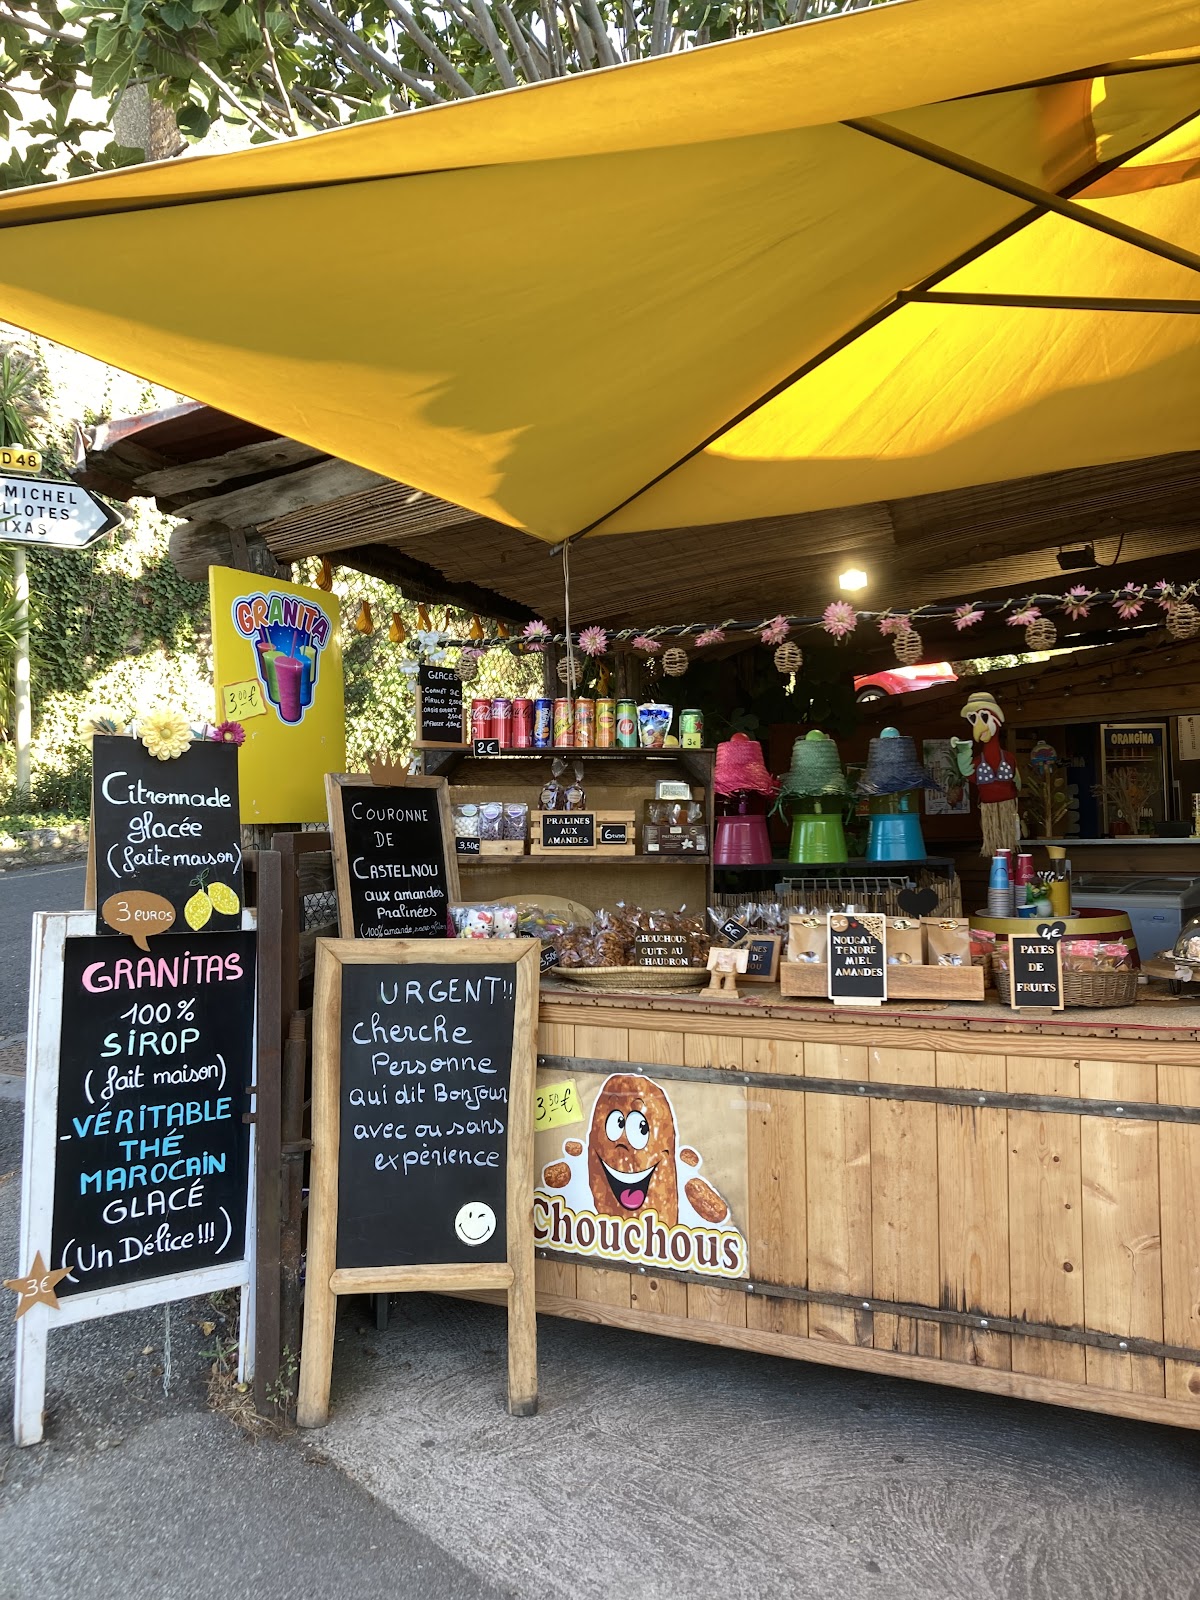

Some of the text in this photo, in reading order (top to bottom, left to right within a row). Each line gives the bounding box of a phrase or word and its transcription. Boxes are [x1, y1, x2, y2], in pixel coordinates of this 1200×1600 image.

[5, 485, 77, 505] MICHEL
[235, 598, 330, 643] GRANITA
[428, 670, 458, 681] GLACES
[1111, 730, 1155, 744] ORANGINA
[477, 742, 499, 754] 2€
[102, 771, 231, 808] Citronnade
[351, 802, 429, 822] COURONNE
[127, 811, 203, 844] glacée
[546, 817, 591, 825] PRALINES
[560, 827, 578, 835] AUX
[373, 831, 394, 848] DE
[458, 841, 480, 850] 3,50€
[547, 836, 589, 844] AMANDES
[352, 857, 438, 880] CASTELNOU
[364, 886, 445, 901] aux amandes
[116, 901, 131, 922] 3
[831, 918, 847, 928] 5€
[724, 923, 740, 940] 6€
[1041, 927, 1063, 940] 4€
[833, 935, 873, 945] NOUGAT
[641, 947, 683, 955] CUITS AU
[835, 945, 877, 955] TENDRE
[1020, 945, 1055, 955] PATES
[639, 957, 689, 966] CHAUDRON
[845, 956, 873, 965] MIEL
[835, 967, 884, 977] AMANDES
[1028, 963, 1044, 972] DE
[1016, 982, 1057, 993] FRUITS
[395, 1083, 426, 1105] dit
[353, 1117, 505, 1140] avec ou sans
[118, 1128, 185, 1162] THÉ
[102, 1178, 204, 1225] GLACÉ
[533, 1197, 740, 1270] Chouchous
[24, 1275, 52, 1298] 3€
